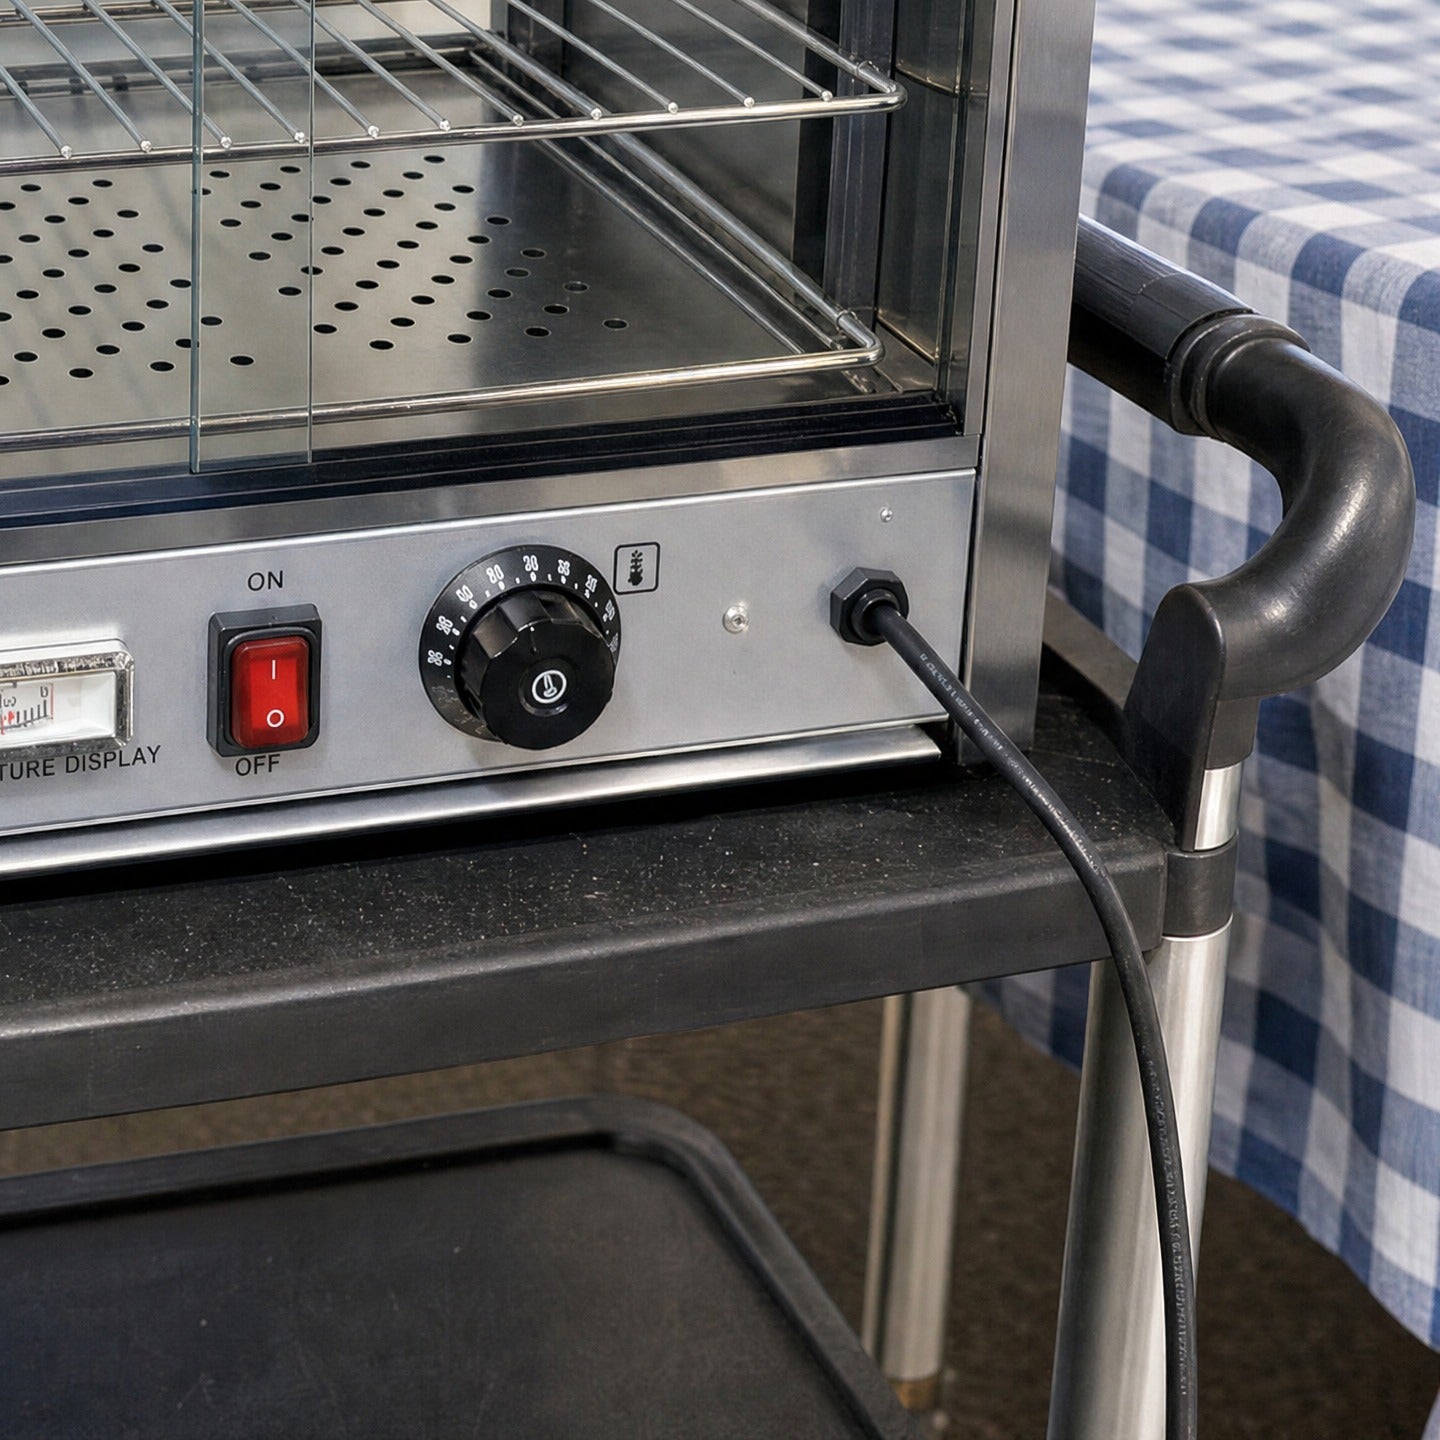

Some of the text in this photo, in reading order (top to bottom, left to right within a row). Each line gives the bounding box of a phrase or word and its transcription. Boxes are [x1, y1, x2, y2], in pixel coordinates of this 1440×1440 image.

[248, 570, 284, 591] ON
[65, 744, 162, 773] DISPLAY
[235, 754, 281, 776] OFF
